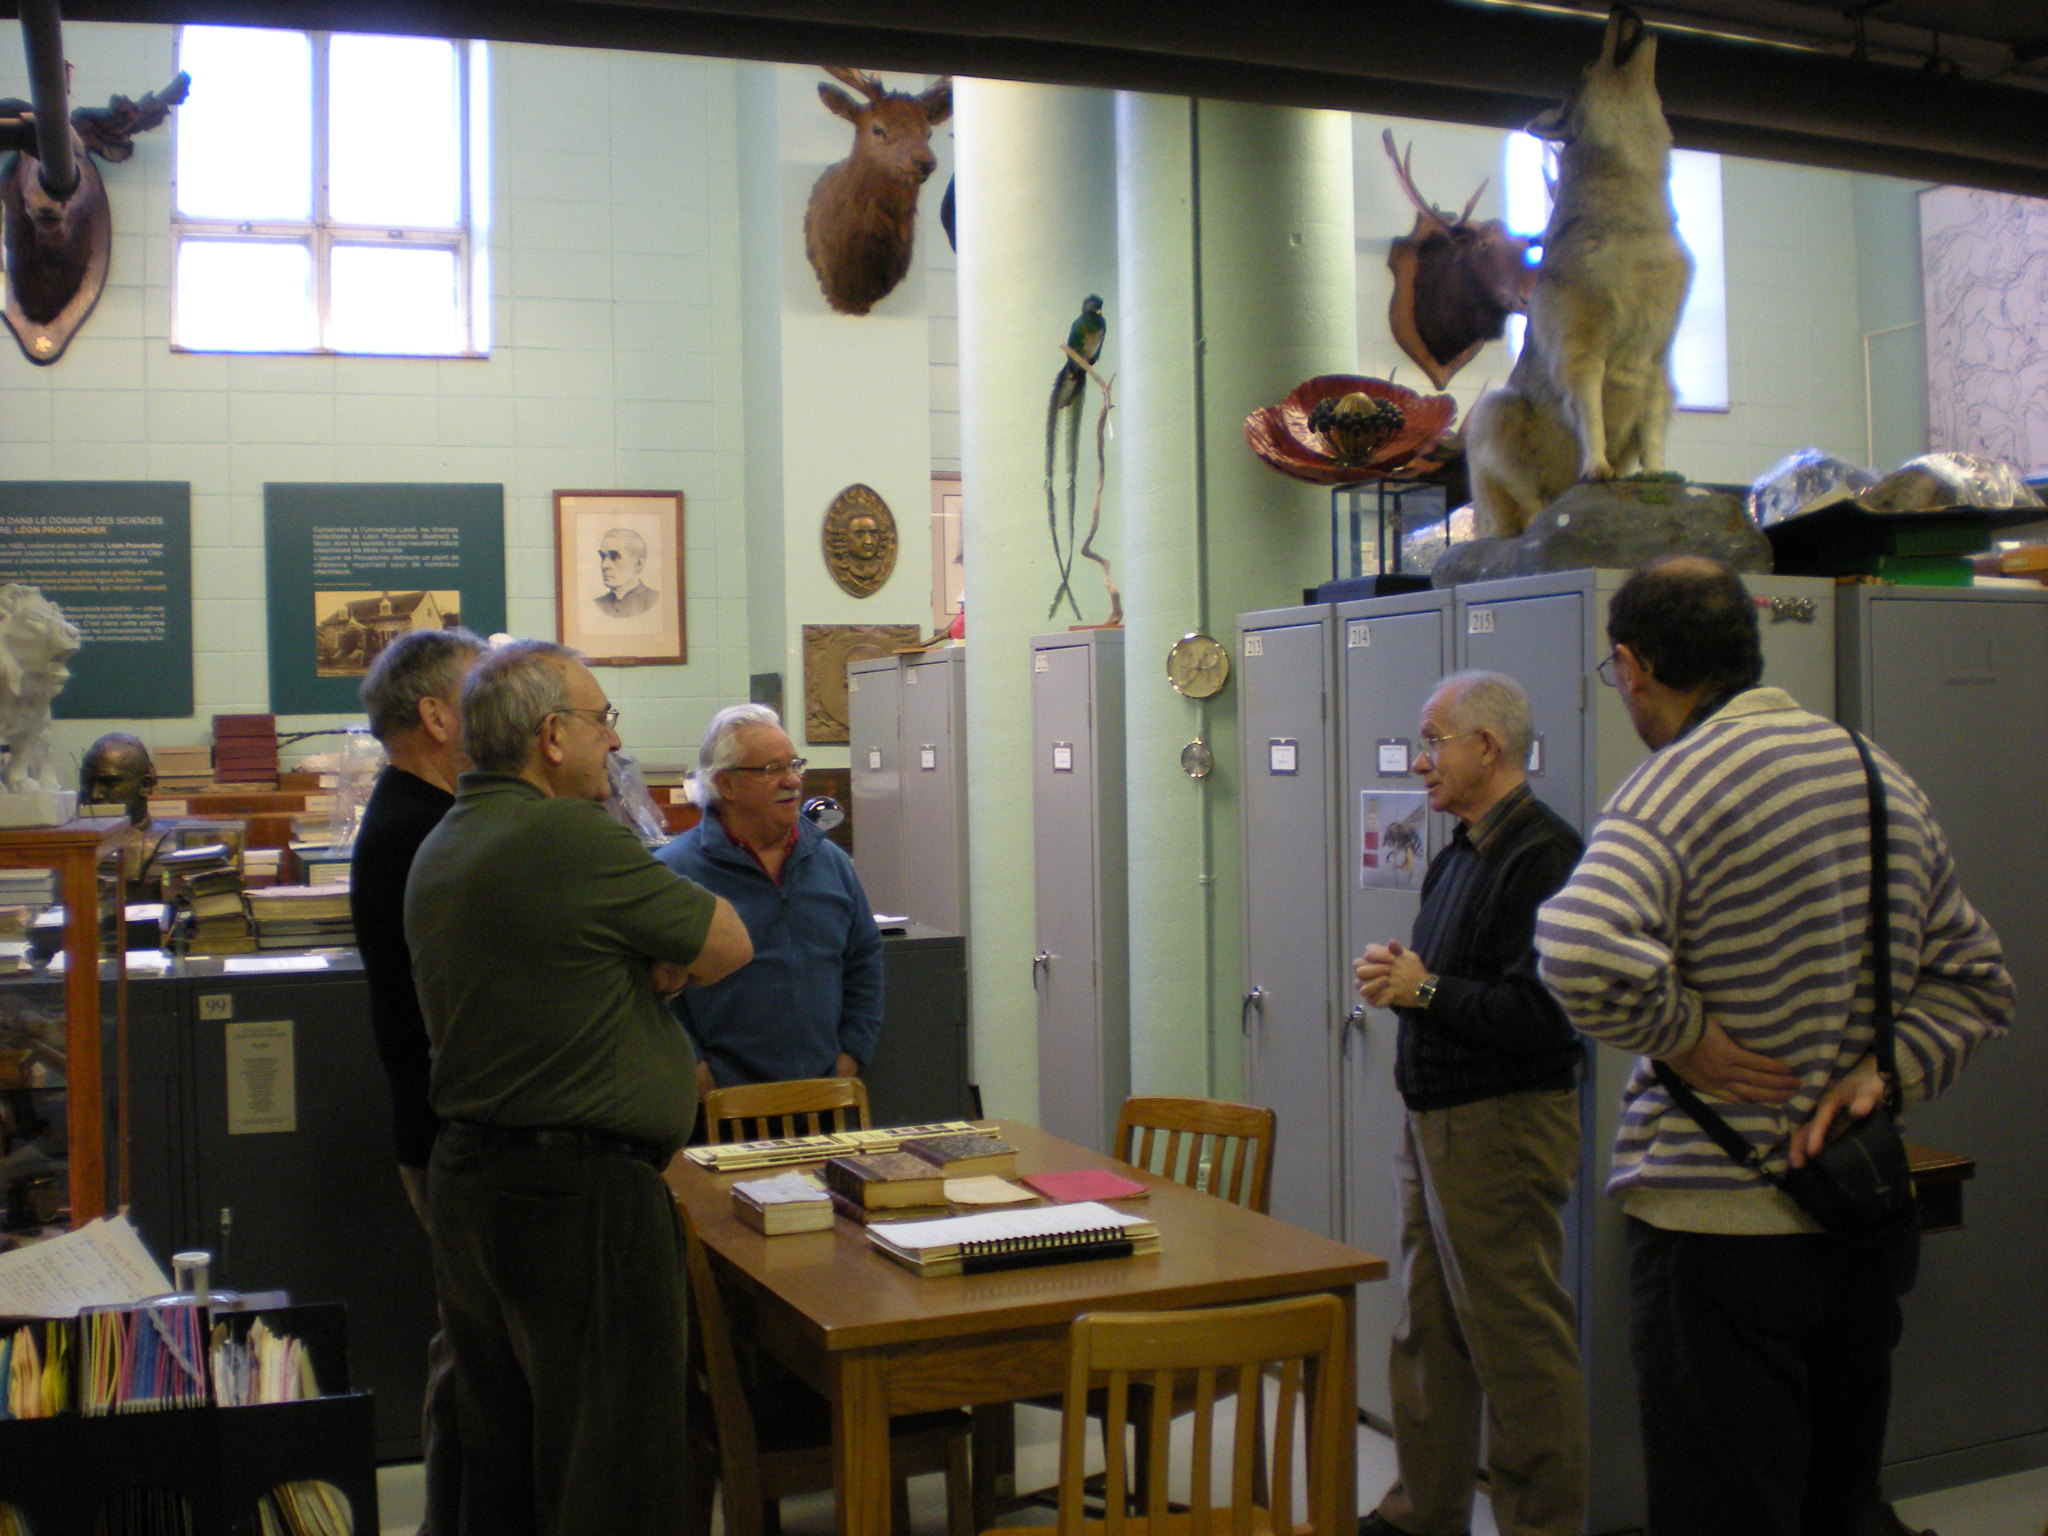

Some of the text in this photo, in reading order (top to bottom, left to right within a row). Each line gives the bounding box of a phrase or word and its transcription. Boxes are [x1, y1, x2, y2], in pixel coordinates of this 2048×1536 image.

[6, 516, 33, 525] DANS
[35, 516, 47, 525] LE
[49, 516, 92, 525] DOMAINE
[95, 516, 114, 525] DES
[116, 516, 164, 525] SCIENCES
[42, 526, 107, 534] PROVANCHER
[1472, 614, 1491, 630] 215
[1351, 628, 1368, 645] 214
[1247, 639, 1261, 654] 213
[205, 998, 226, 1014] 99
